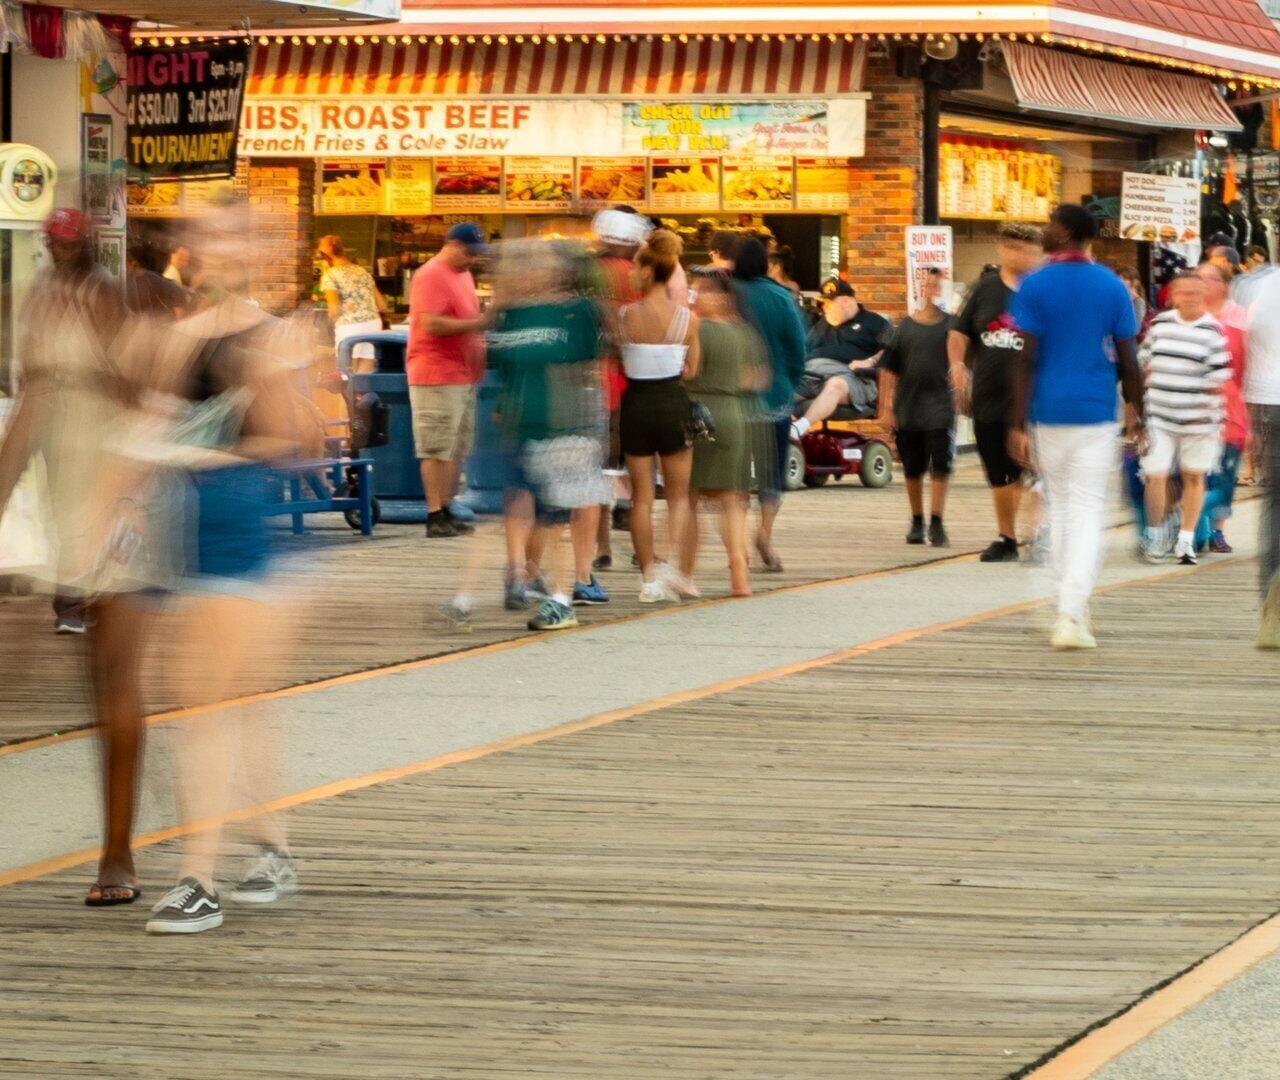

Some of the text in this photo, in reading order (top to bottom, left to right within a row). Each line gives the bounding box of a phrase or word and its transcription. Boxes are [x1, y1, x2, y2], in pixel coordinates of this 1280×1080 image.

[138, 91, 179, 127] $50.00
[187, 89, 206, 124] 3rd
[638, 104, 695, 121] CHECK
[244, 104, 531, 134] IBS, ROAST BEEF
[313, 134, 366, 151] Fries
[375, 134, 390, 151] &
[400, 133, 446, 151] Cole
[454, 132, 508, 151] Slaw
[912, 233, 947, 246] BUY ONE
[915, 250, 946, 263] DINNER
